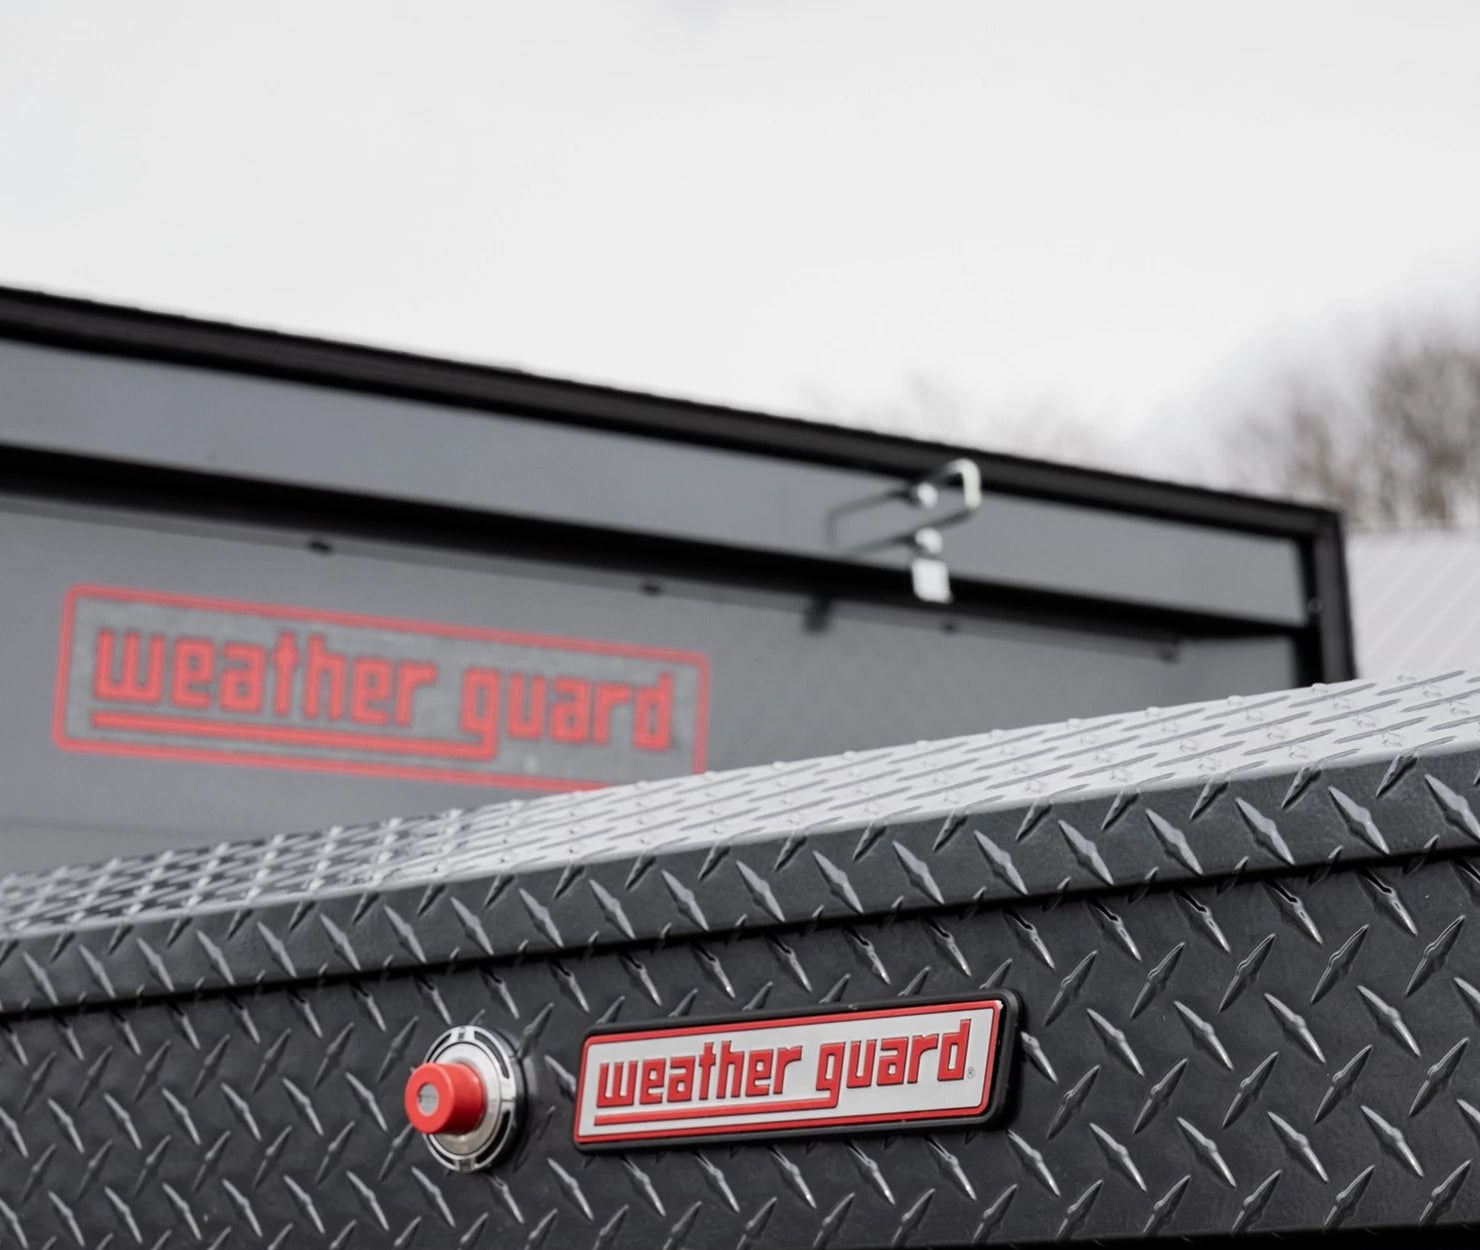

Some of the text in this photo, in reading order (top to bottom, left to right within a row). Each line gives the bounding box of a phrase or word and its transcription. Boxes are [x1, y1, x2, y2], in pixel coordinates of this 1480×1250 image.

[93, 626, 676, 761] weather guard
[596, 1018, 973, 1108] weather guard
